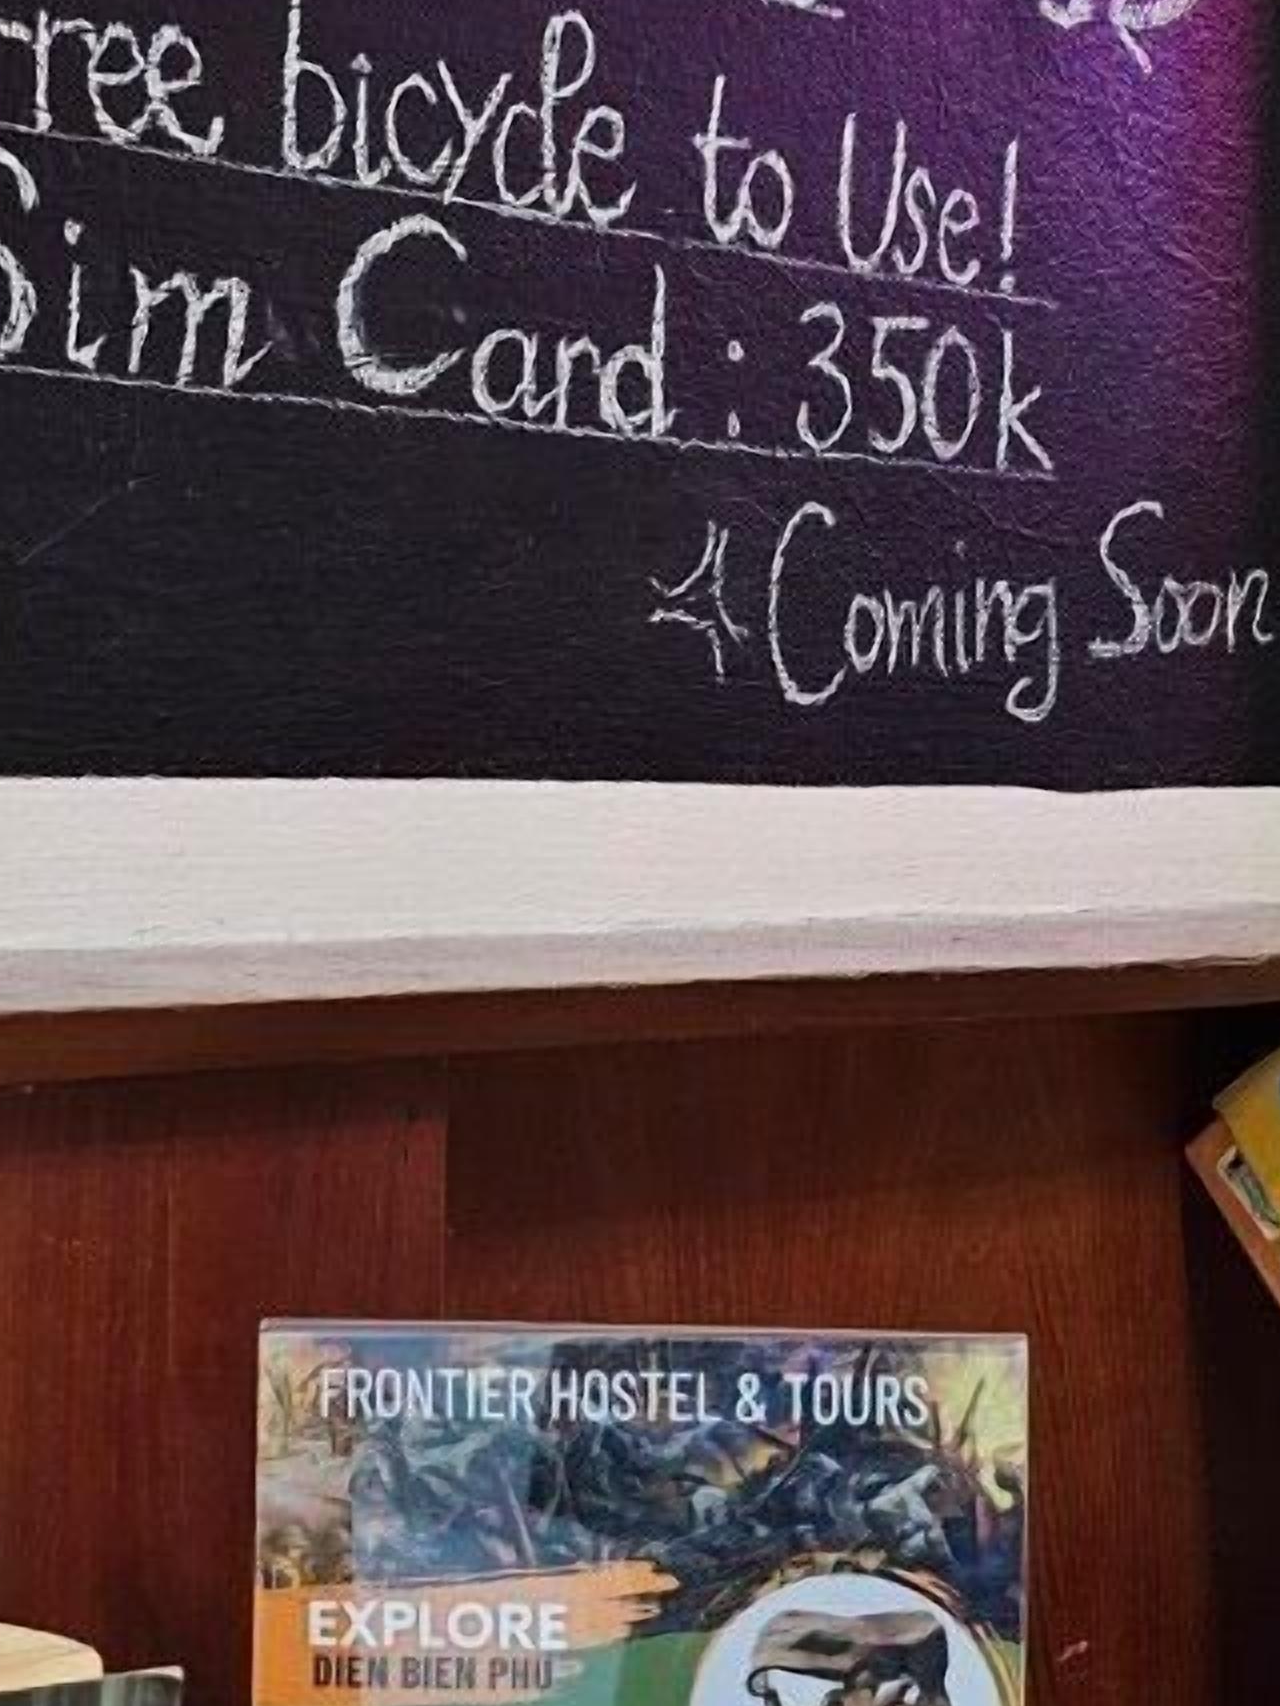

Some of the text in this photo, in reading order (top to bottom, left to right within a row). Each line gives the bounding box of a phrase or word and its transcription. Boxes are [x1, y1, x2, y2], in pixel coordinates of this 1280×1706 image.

[692, 75, 796, 249] to
[832, 113, 1024, 287] Use!
[336, 213, 672, 441] Card
[766, 499, 1276, 723] Coming Soon
[318, 1365, 930, 1428] FRONTIER HOSTEL & TOURS
[308, 1599, 570, 1651] EXPLORE
[311, 1655, 554, 1691] DIEN BIEN PHU
